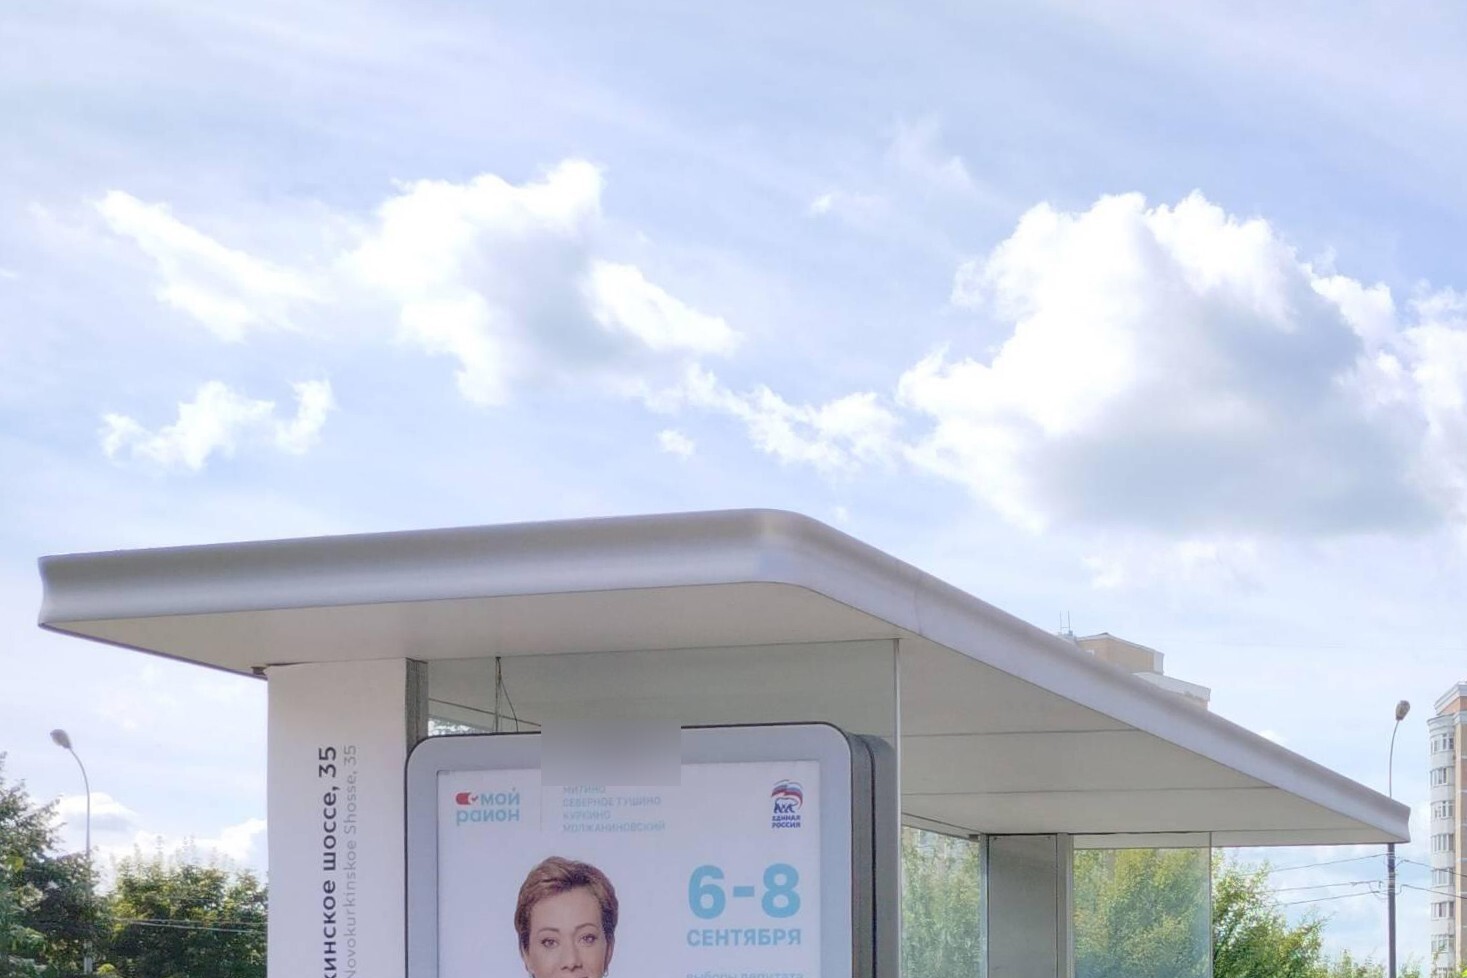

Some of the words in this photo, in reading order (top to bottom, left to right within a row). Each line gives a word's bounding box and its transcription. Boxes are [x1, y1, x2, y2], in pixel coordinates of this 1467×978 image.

[318, 746, 337, 779] 35
[342, 744, 357, 767] 35
[342, 770, 359, 835] Shosse,
[480, 786, 520, 806] мой
[321, 785, 340, 872] шоссе,
[686, 928, 802, 947] СЕНТЯБРЯ
